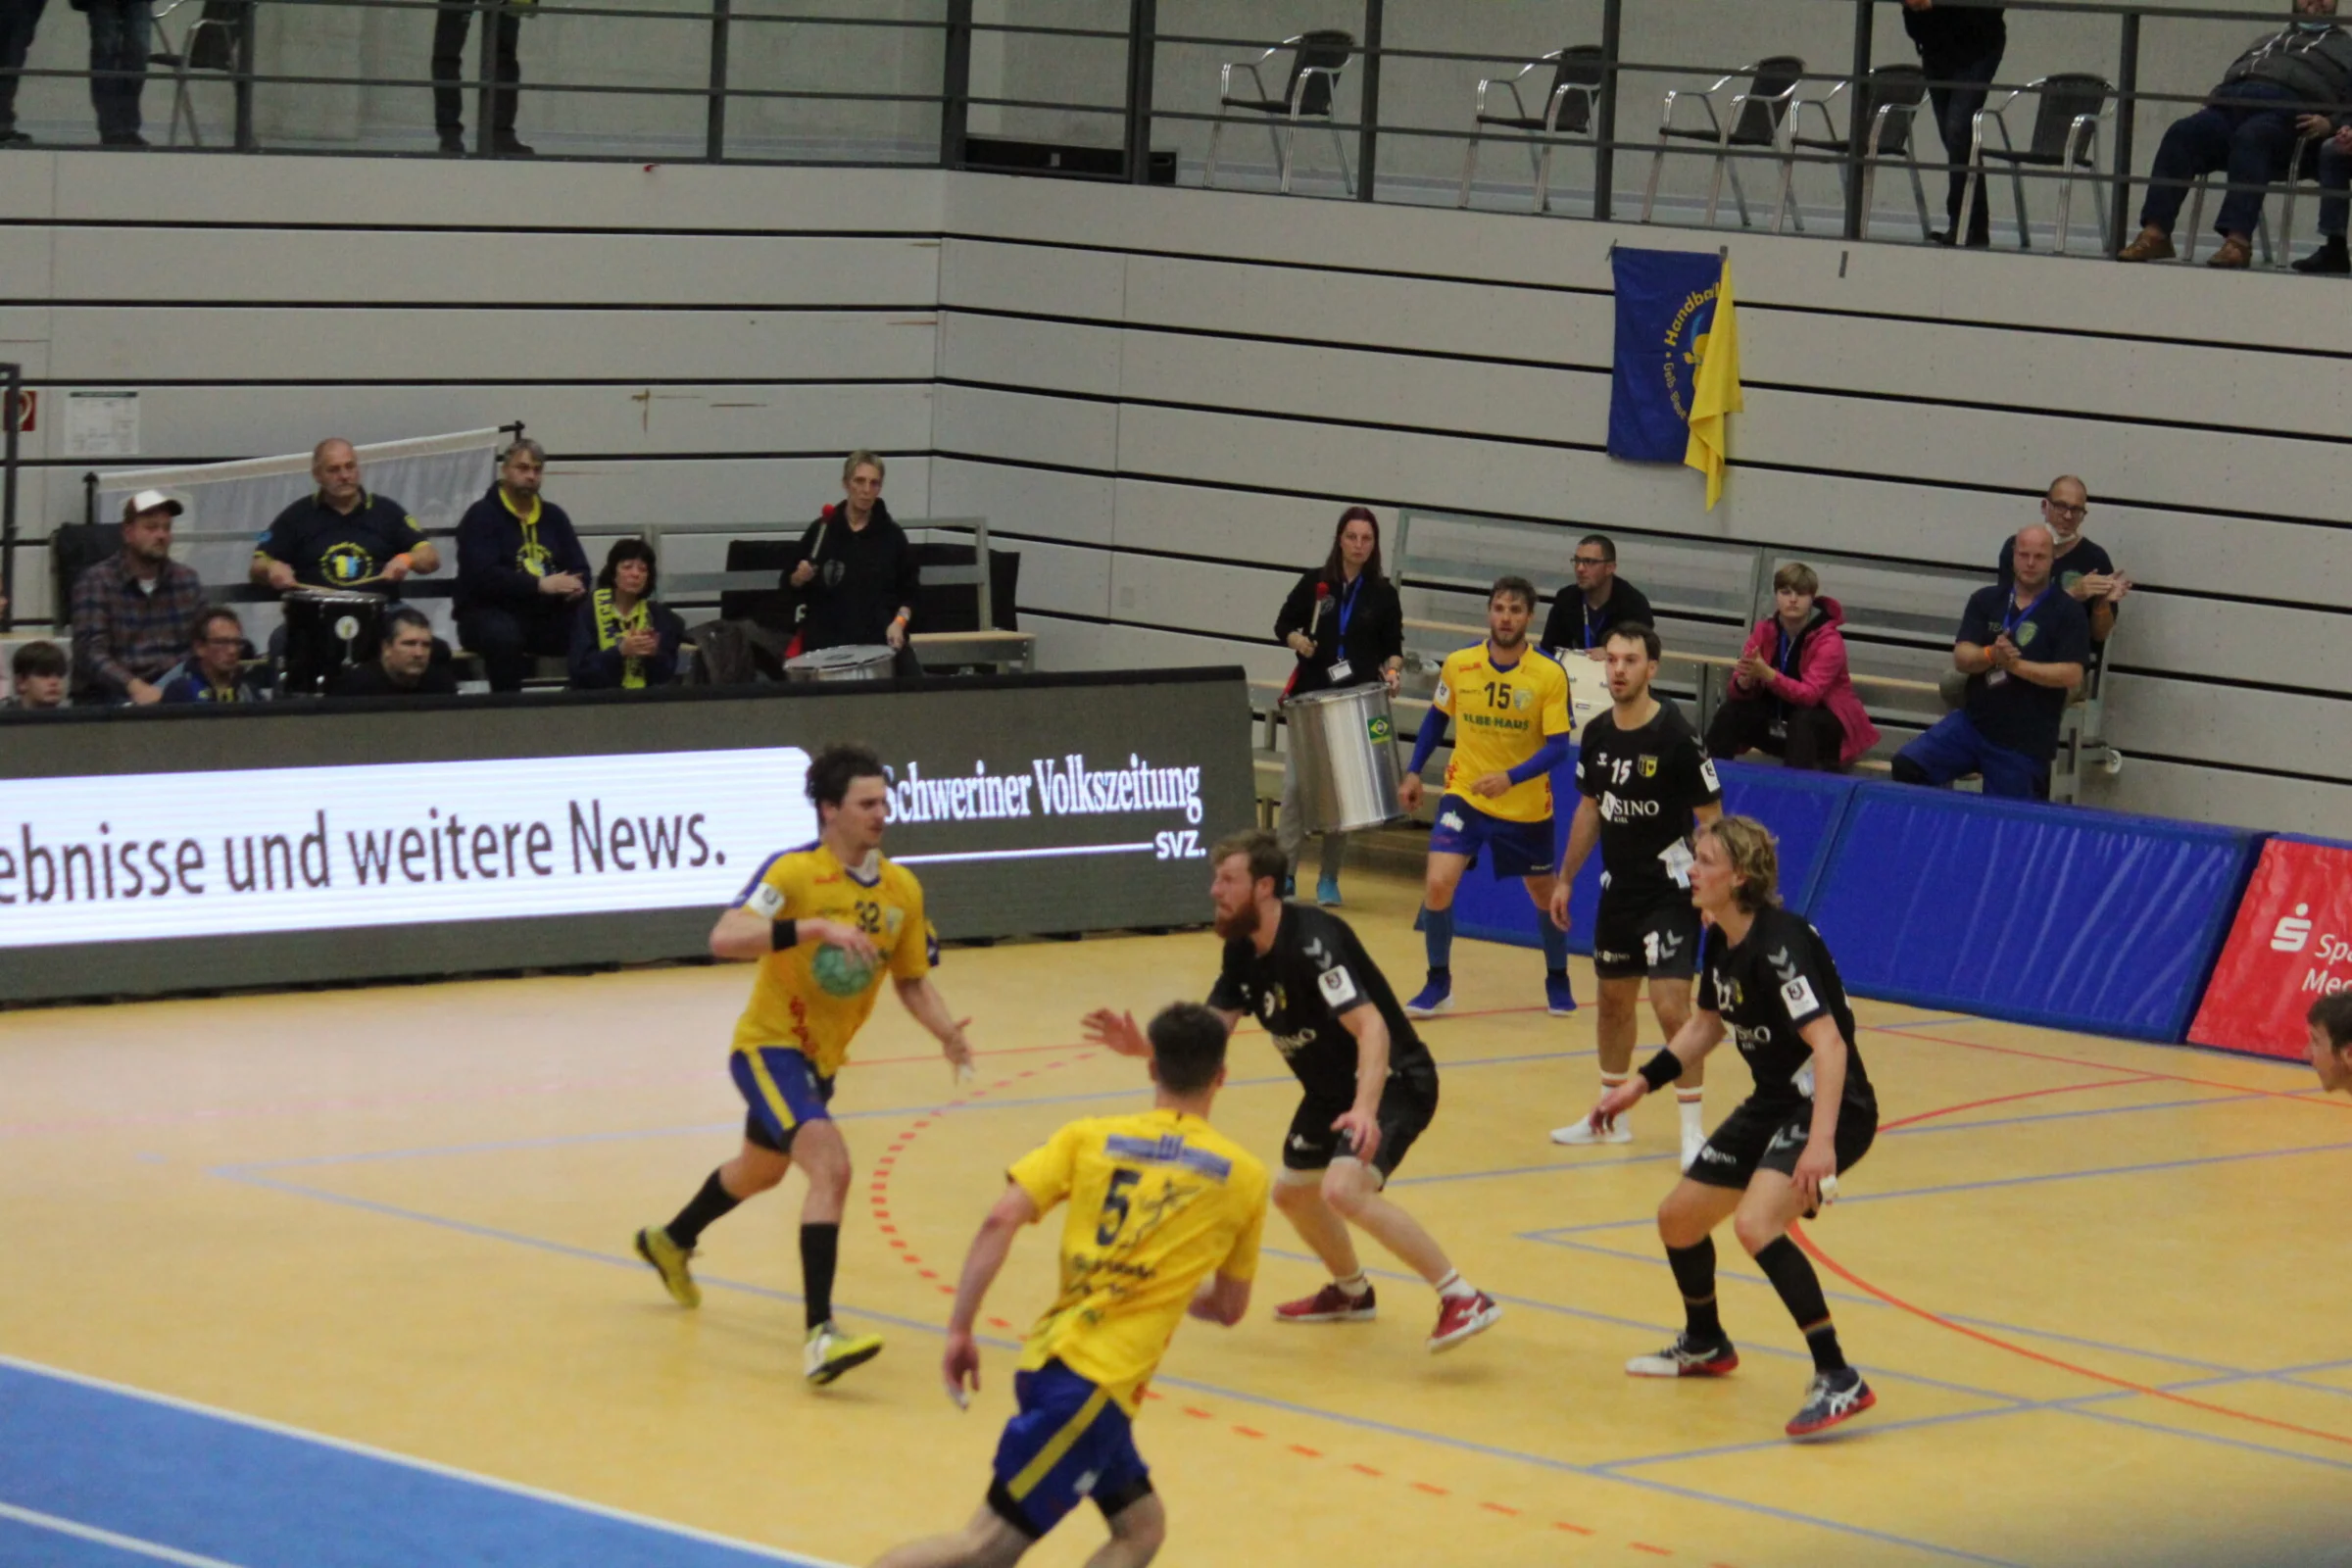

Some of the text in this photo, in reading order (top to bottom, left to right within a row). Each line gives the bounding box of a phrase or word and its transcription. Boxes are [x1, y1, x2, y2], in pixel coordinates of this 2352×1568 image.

[1485, 681, 1512, 710] 15
[1611, 758, 1632, 785] 15
[883, 753, 1202, 824] Schweriner Volkszeitung
[0, 799, 726, 904] ebnisse und weitere News.
[1155, 830, 1206, 858] svz.
[855, 901, 880, 934] 32
[1096, 1168, 1143, 1246] 5
